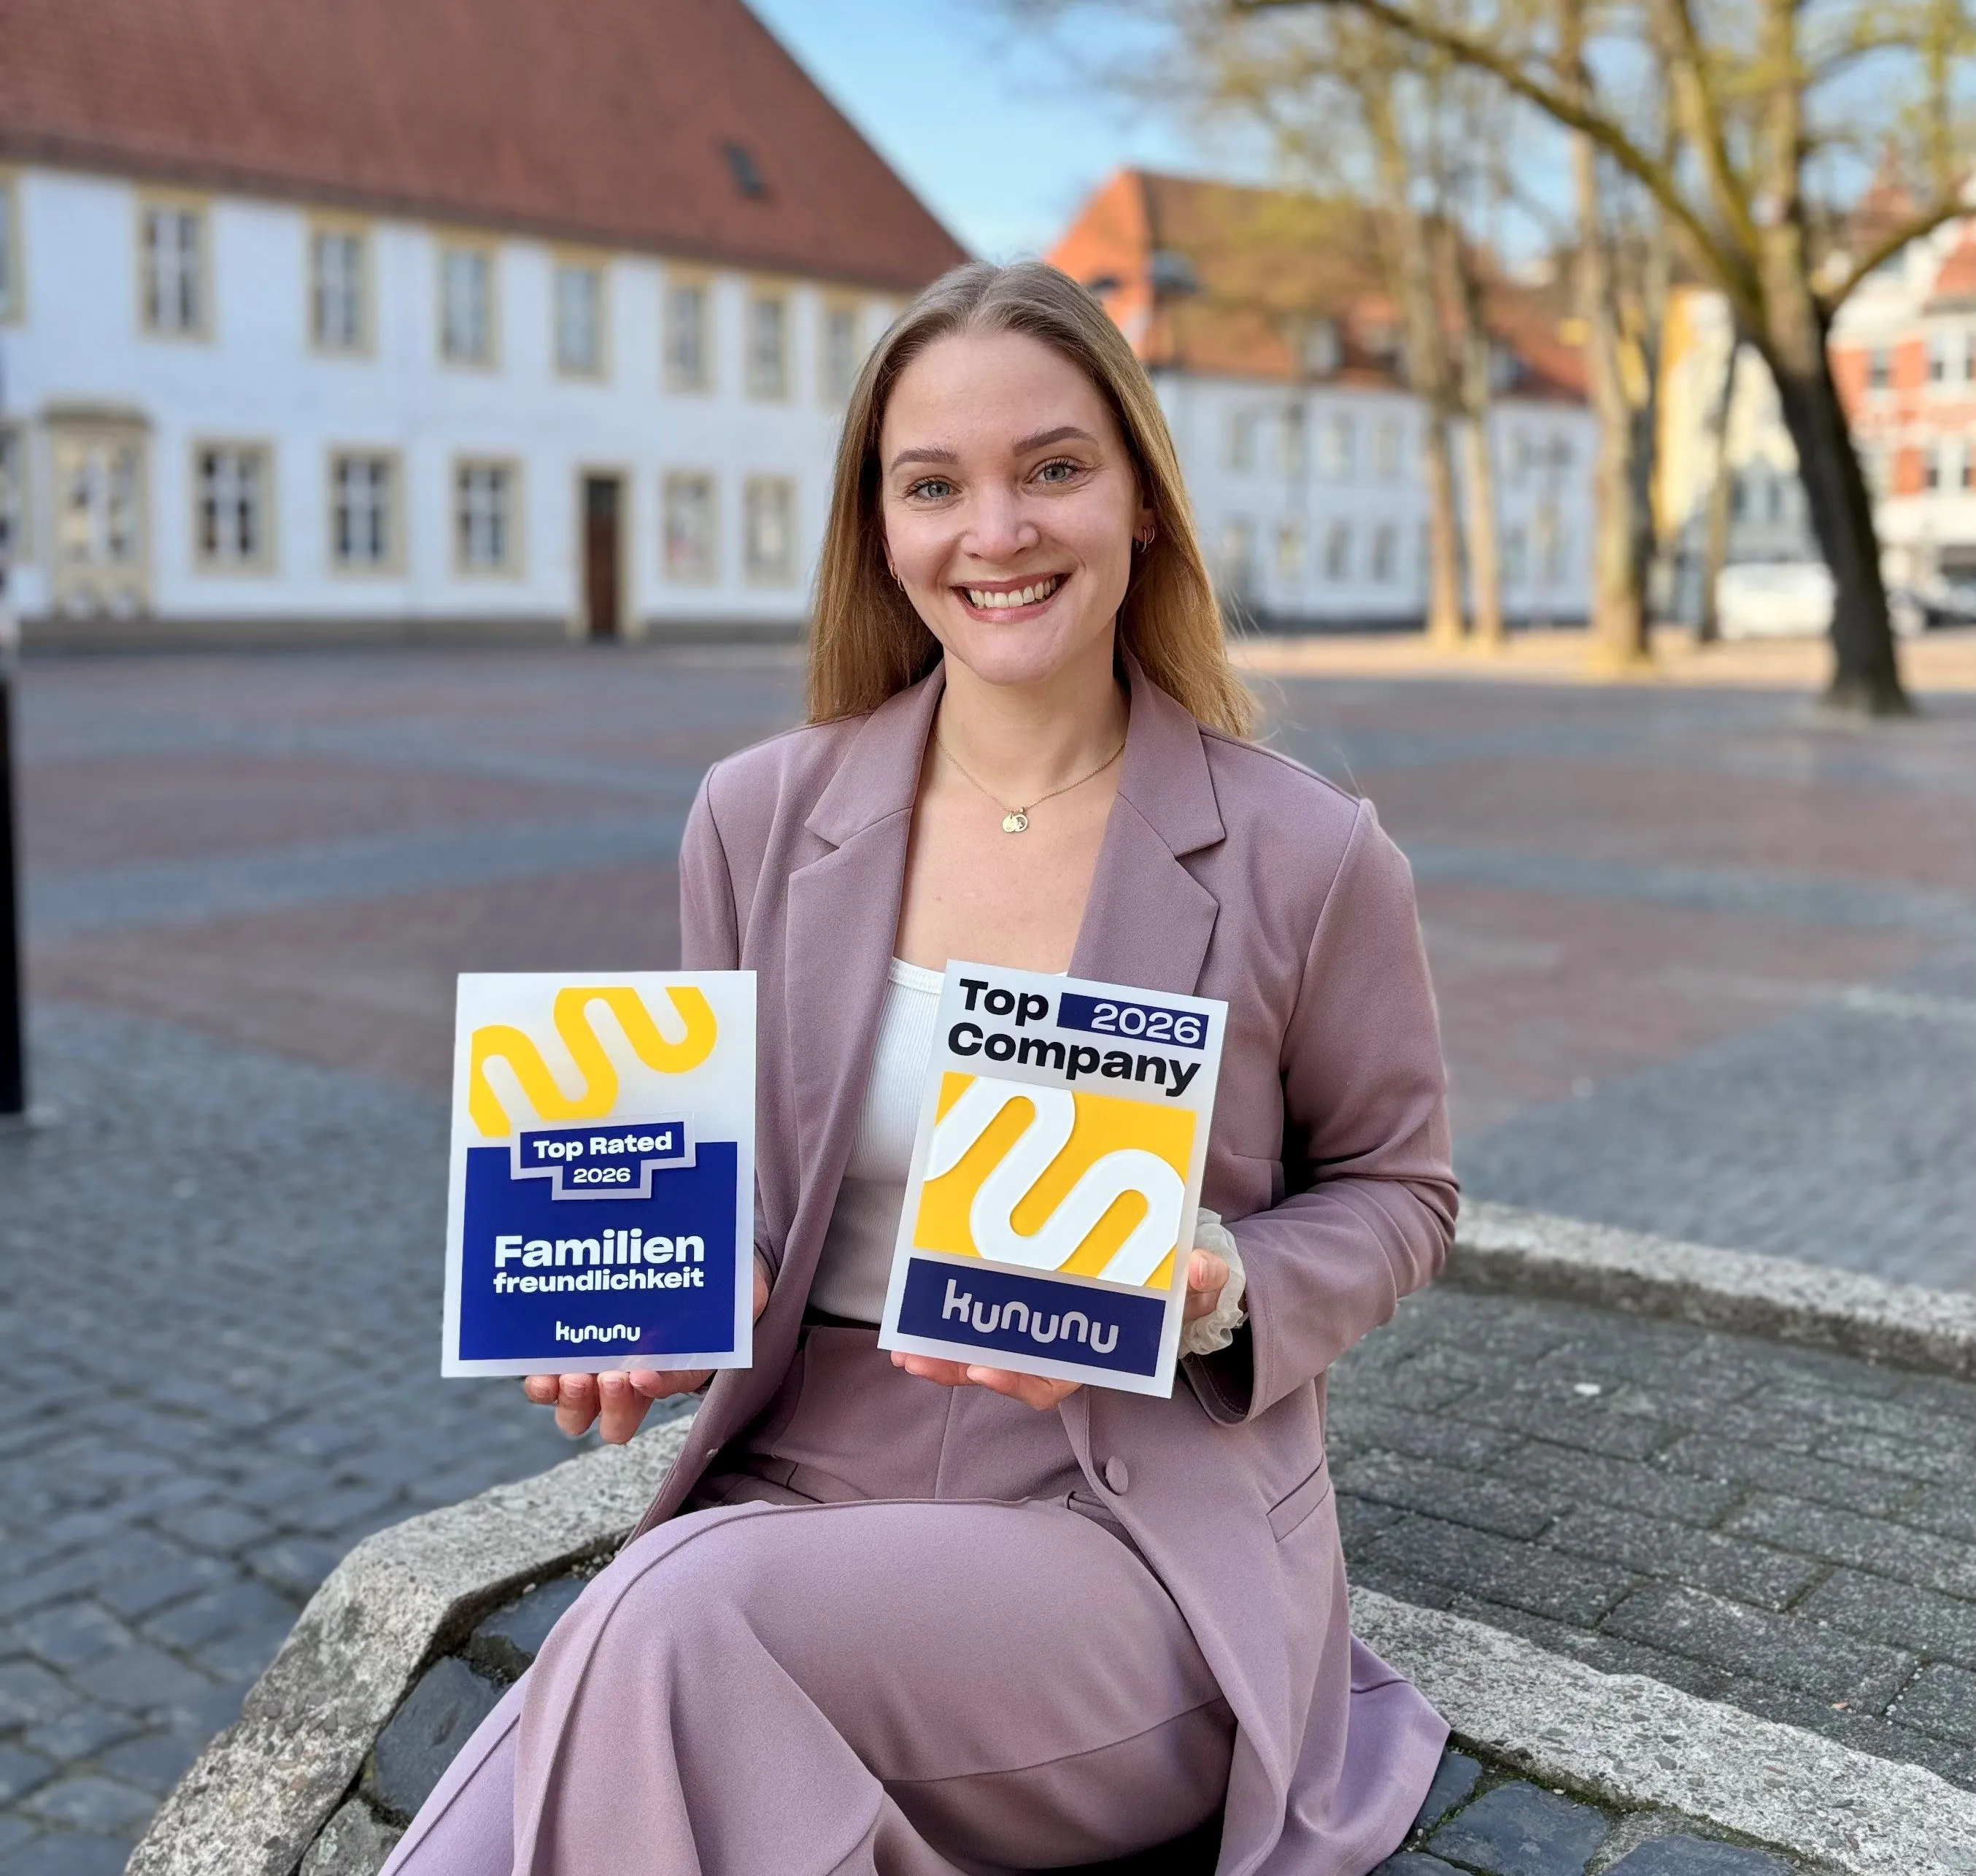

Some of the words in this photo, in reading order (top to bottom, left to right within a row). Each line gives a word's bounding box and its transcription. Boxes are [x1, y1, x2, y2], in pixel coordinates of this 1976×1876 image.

[959, 978, 1049, 1026] Top
[1091, 1003, 1200, 1043] 2026
[948, 1022, 1201, 1097] Company
[533, 1140, 583, 1161] Top
[590, 1131, 672, 1155] Rated
[573, 1167, 630, 1184] 2026
[495, 1228, 704, 1268] Familien
[493, 1266, 704, 1293] freundlichkeit
[555, 1321, 640, 1343] kununu
[942, 1279, 1119, 1354] kununu
